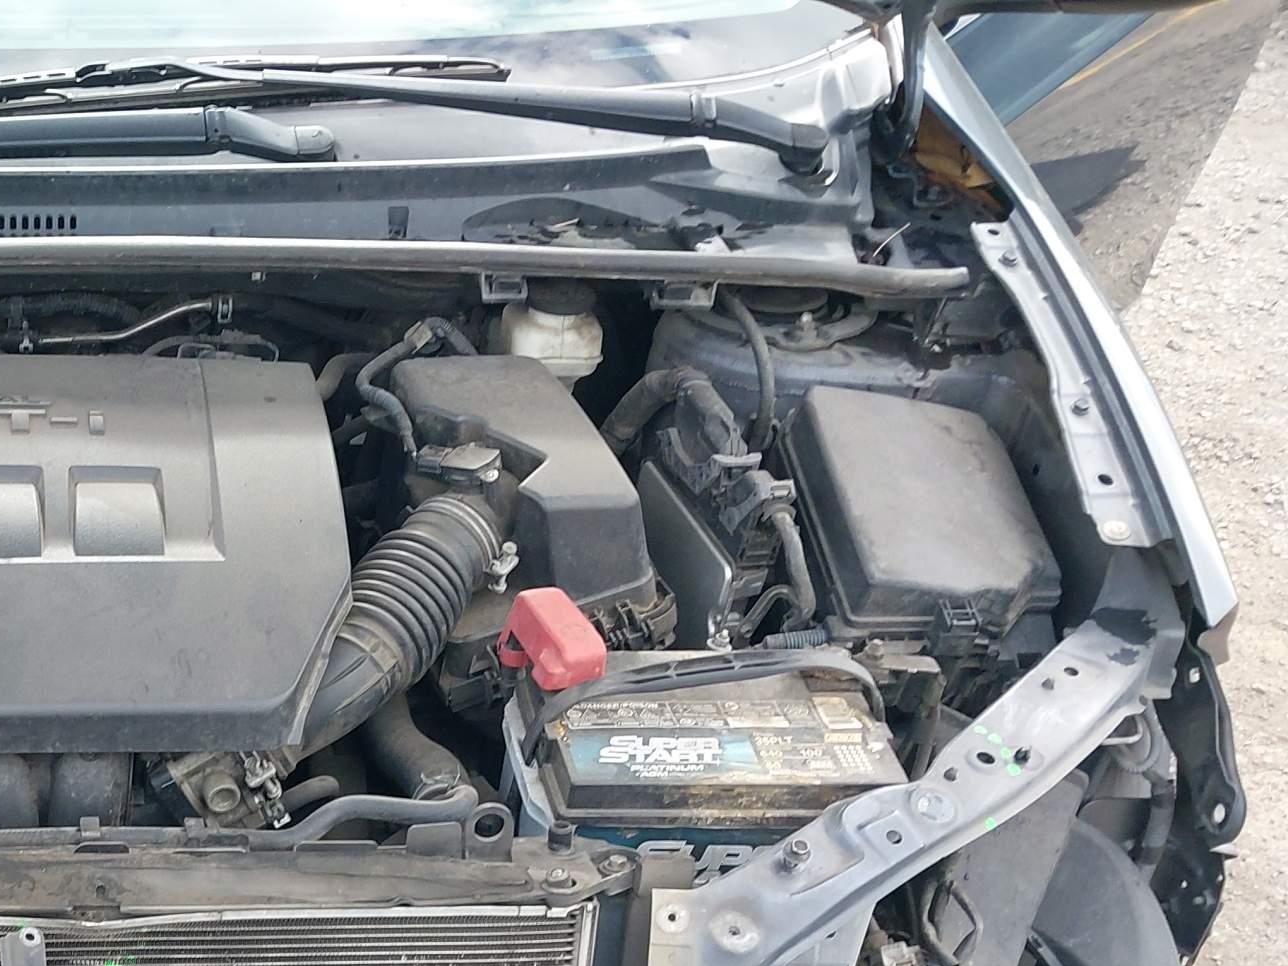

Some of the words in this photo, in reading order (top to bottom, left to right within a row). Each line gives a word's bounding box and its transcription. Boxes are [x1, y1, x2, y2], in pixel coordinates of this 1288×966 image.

[609, 735, 720, 750] SUPER
[598, 747, 723, 765] START
[630, 764, 705, 772] PLATINUM
